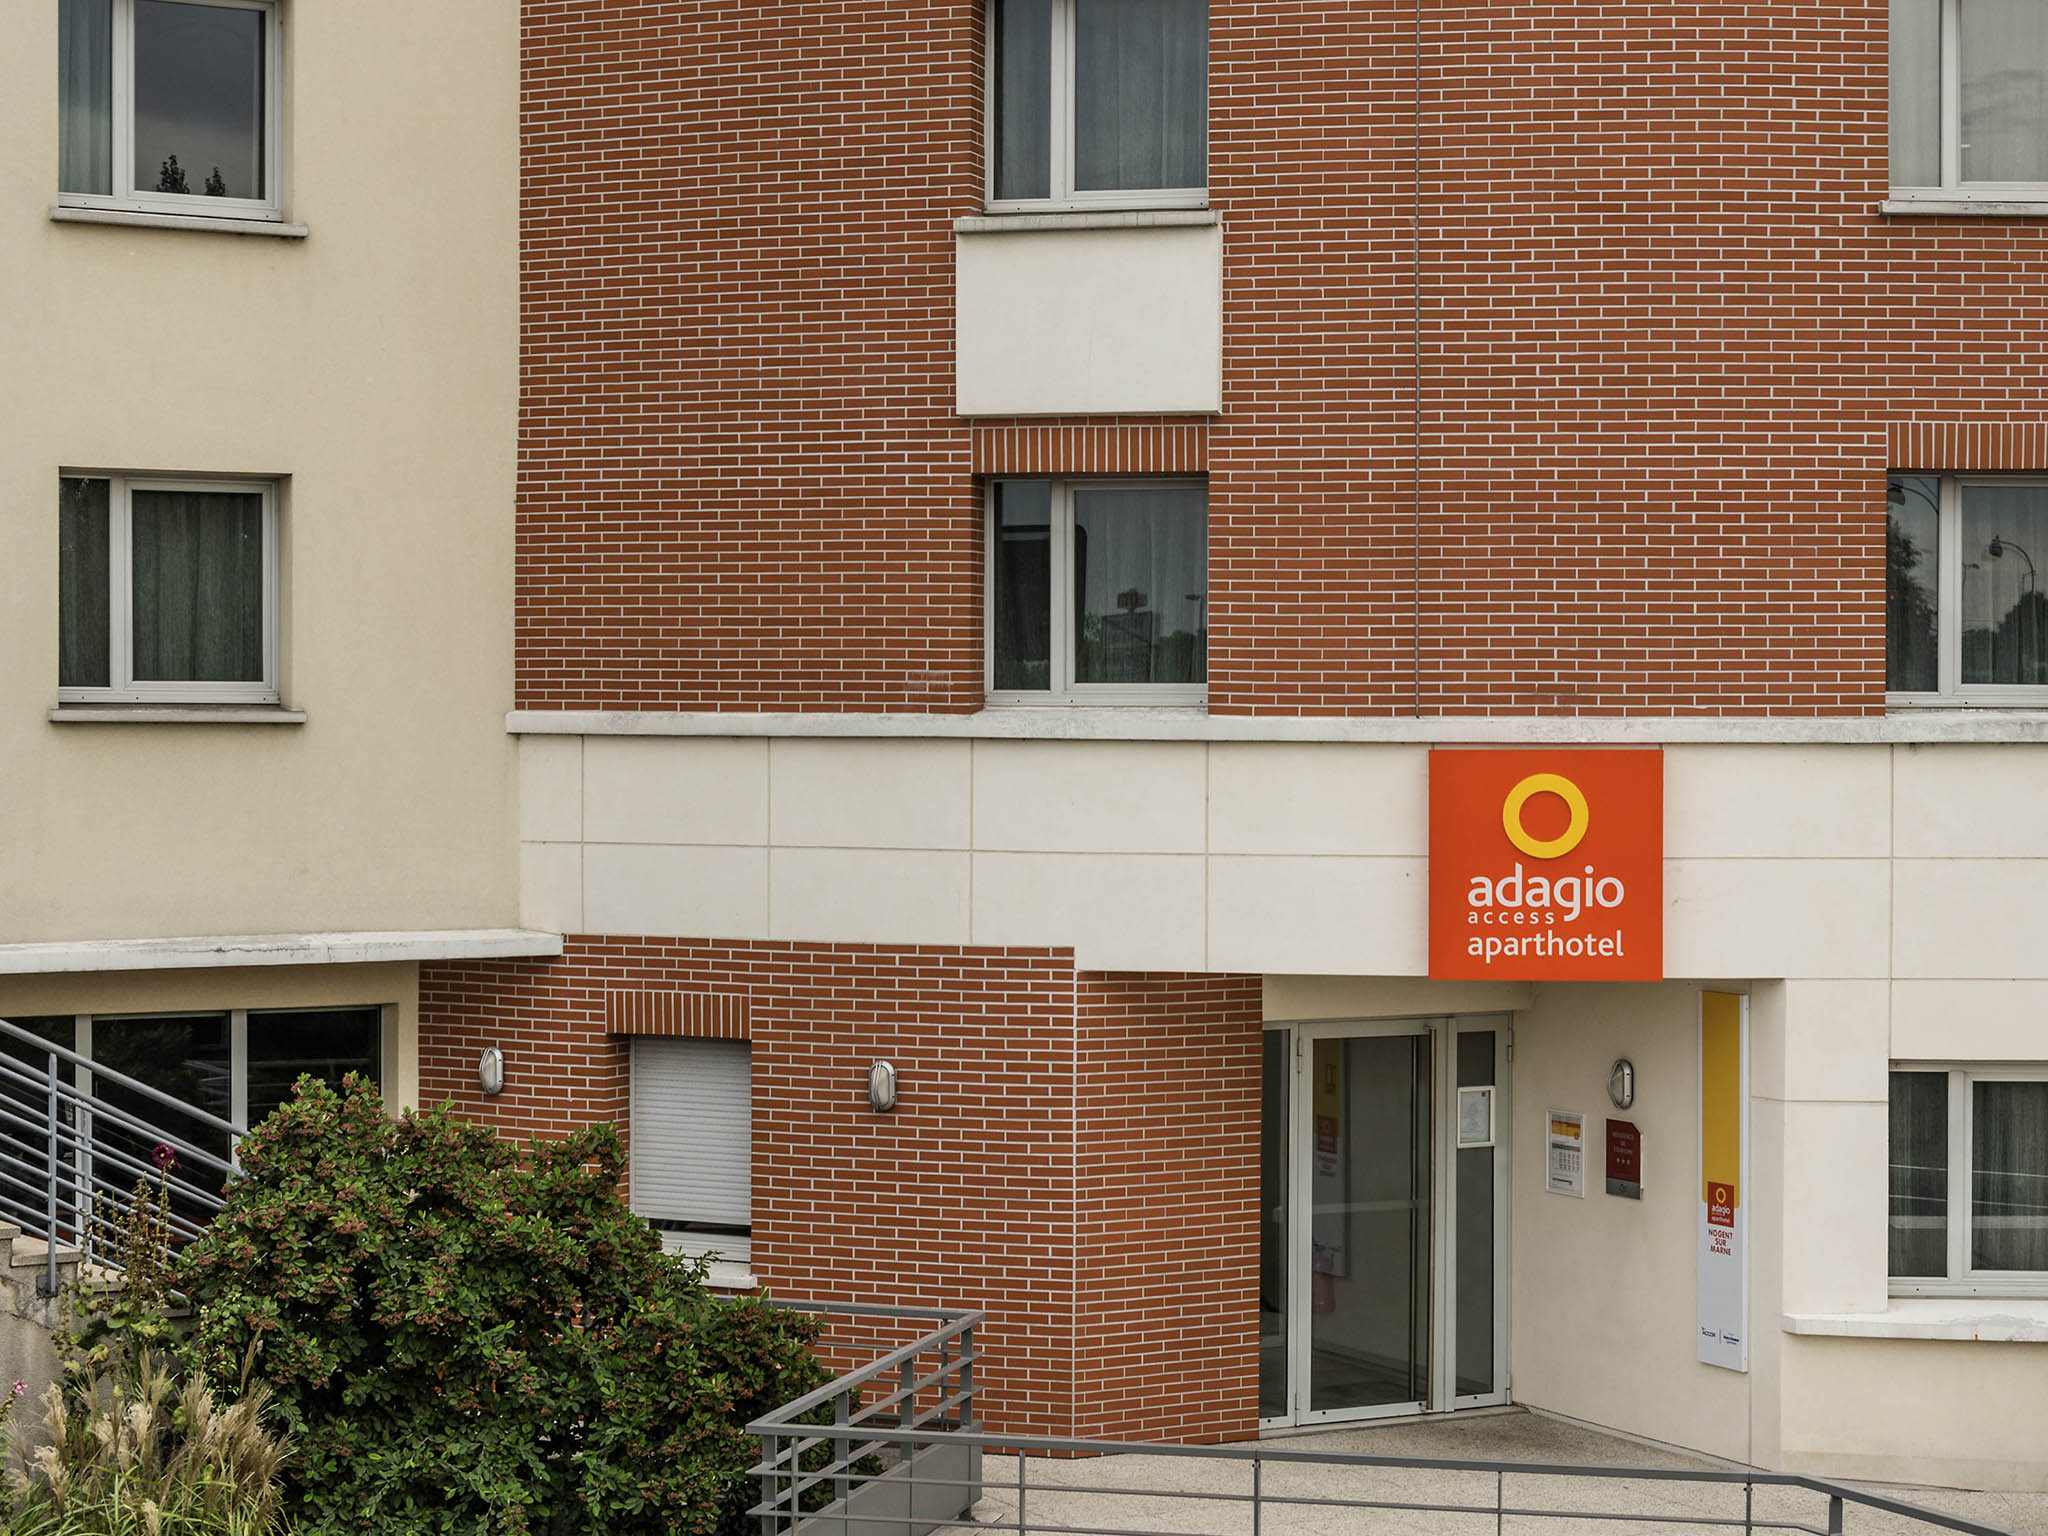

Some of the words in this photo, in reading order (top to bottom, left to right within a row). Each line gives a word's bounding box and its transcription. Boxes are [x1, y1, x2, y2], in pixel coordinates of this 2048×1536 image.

[1467, 862, 1625, 922] adagio
[1467, 911, 1555, 925] access
[1467, 929, 1624, 964] aparthotel
[1708, 1228, 1733, 1240] NOGENT
[1714, 1237, 1727, 1247] SUR
[1710, 1245, 1732, 1256] MARNE
